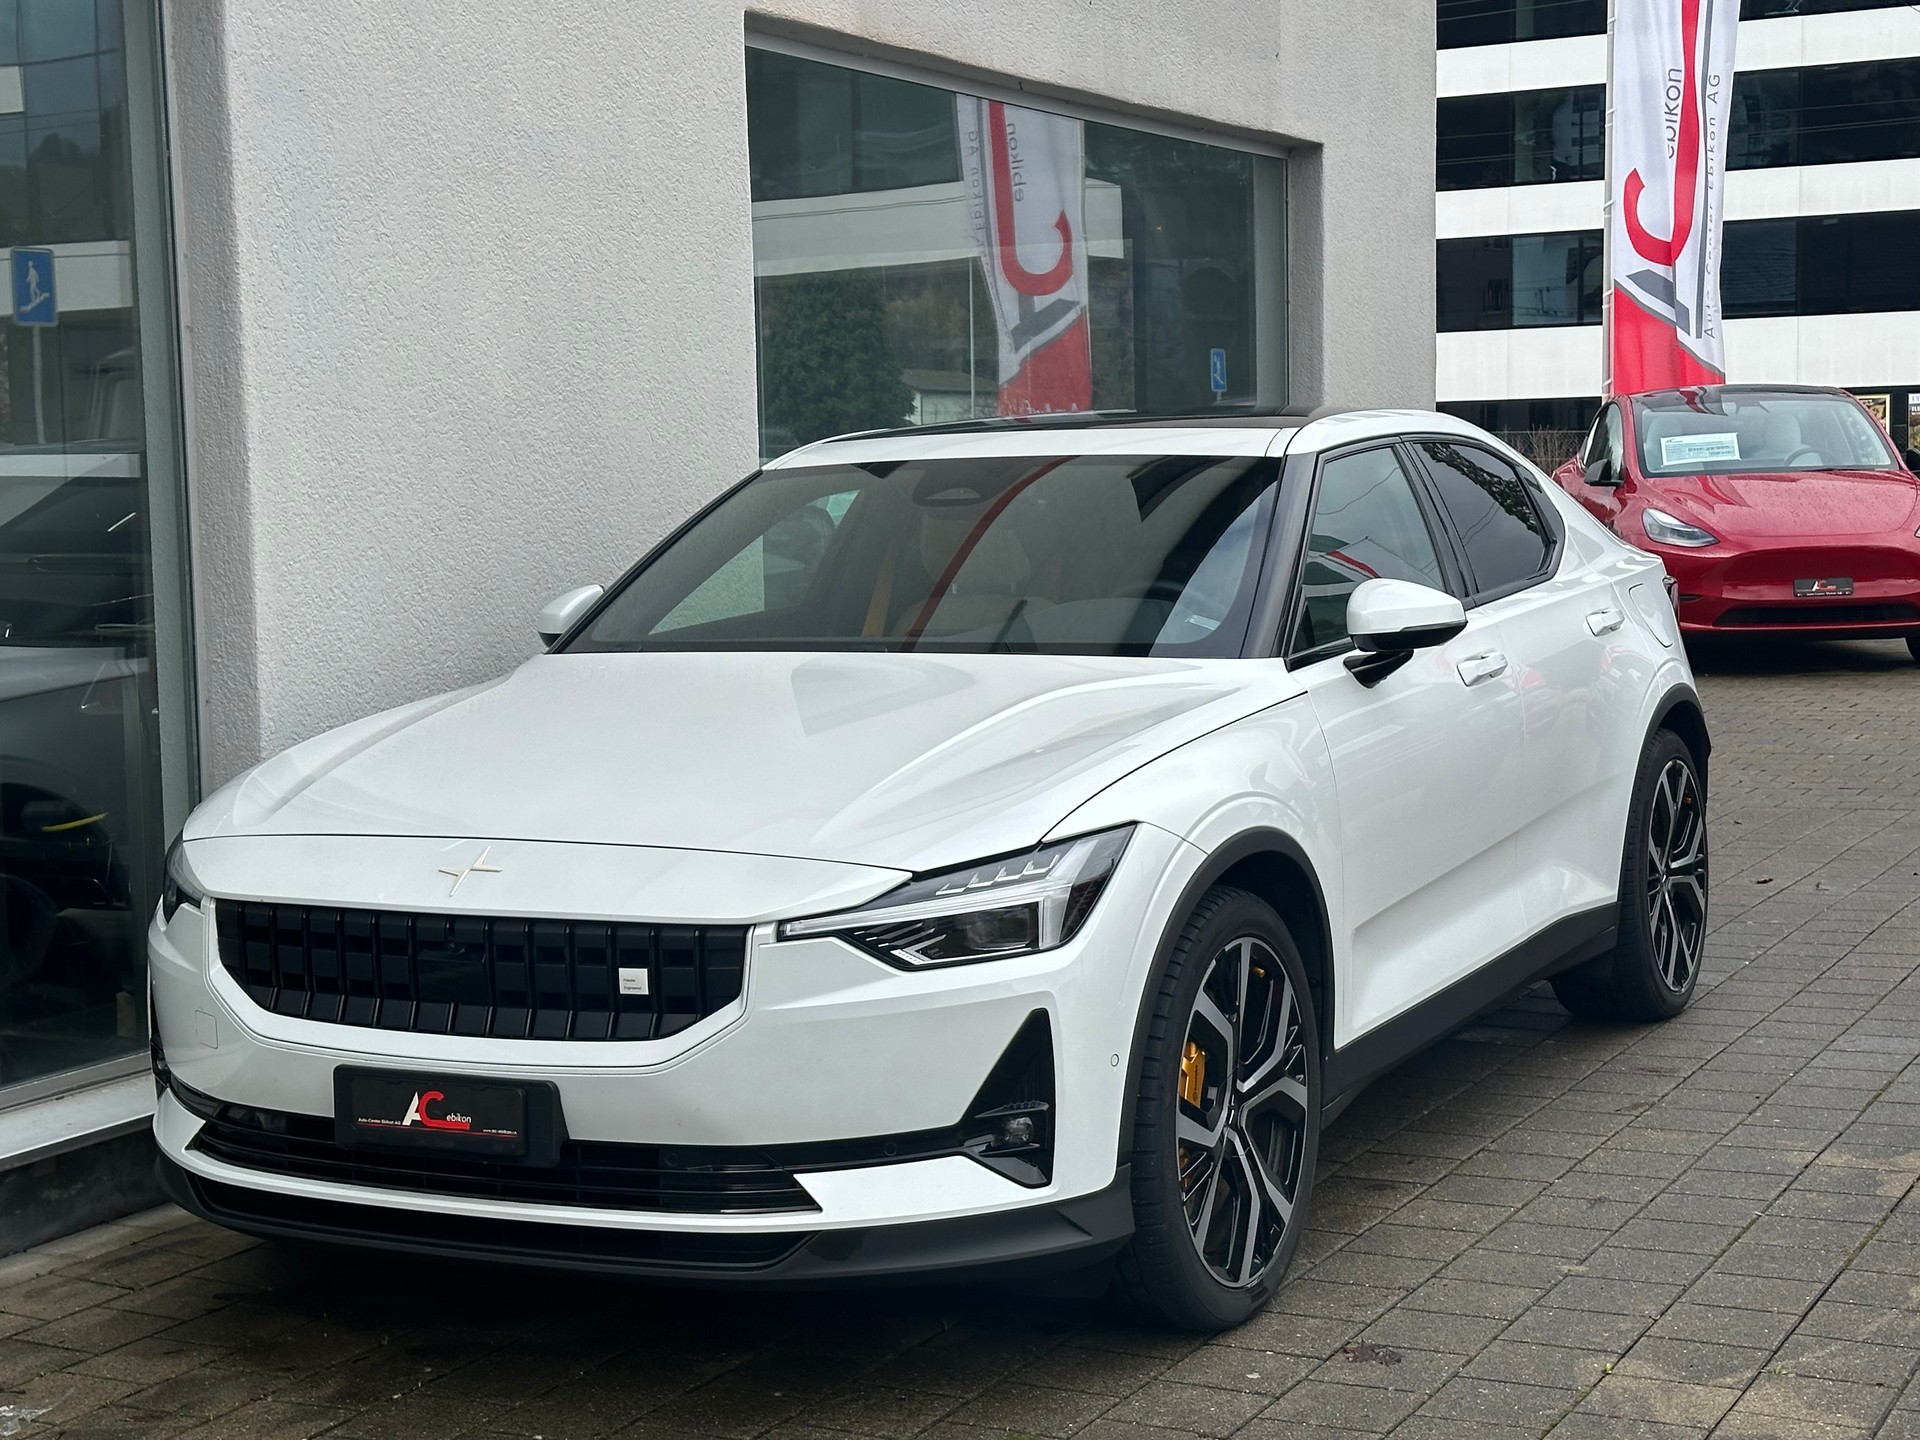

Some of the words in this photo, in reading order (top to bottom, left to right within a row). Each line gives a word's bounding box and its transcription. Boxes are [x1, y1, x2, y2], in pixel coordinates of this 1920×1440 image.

[1706, 74, 1720, 104] AG
[402, 1090, 470, 1130] AC
[446, 1112, 472, 1123] ebikon
